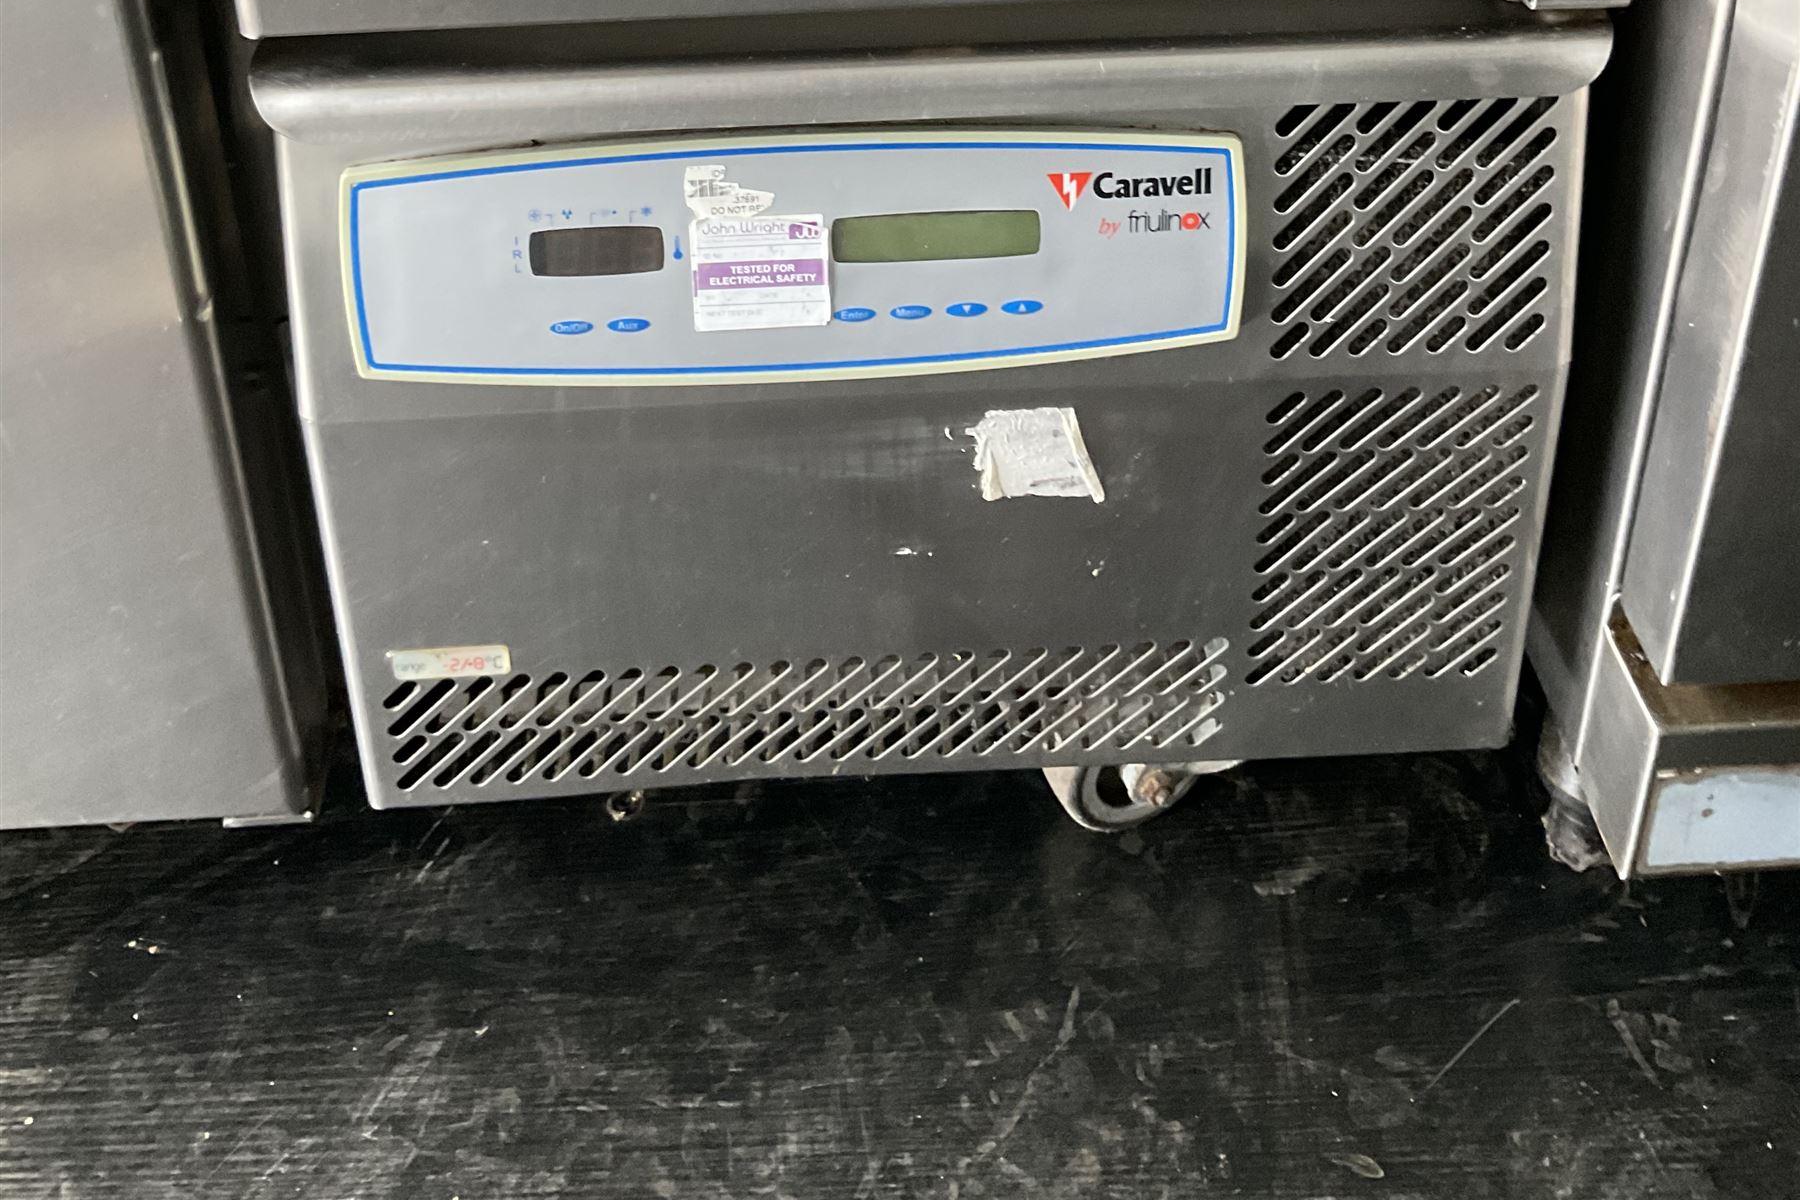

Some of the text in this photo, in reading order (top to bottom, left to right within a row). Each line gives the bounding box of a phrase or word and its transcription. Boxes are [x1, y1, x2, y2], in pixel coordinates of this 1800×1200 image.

[1093, 167, 1212, 199] Caravell
[711, 206, 725, 215] DO
[727, 204, 747, 214] NOT
[702, 221, 785, 235] John Wright
[1098, 209, 1211, 240] by friulinox
[730, 263, 796, 275] TESTED FOR
[709, 272, 817, 286] ELECTRICAL SAFETY
